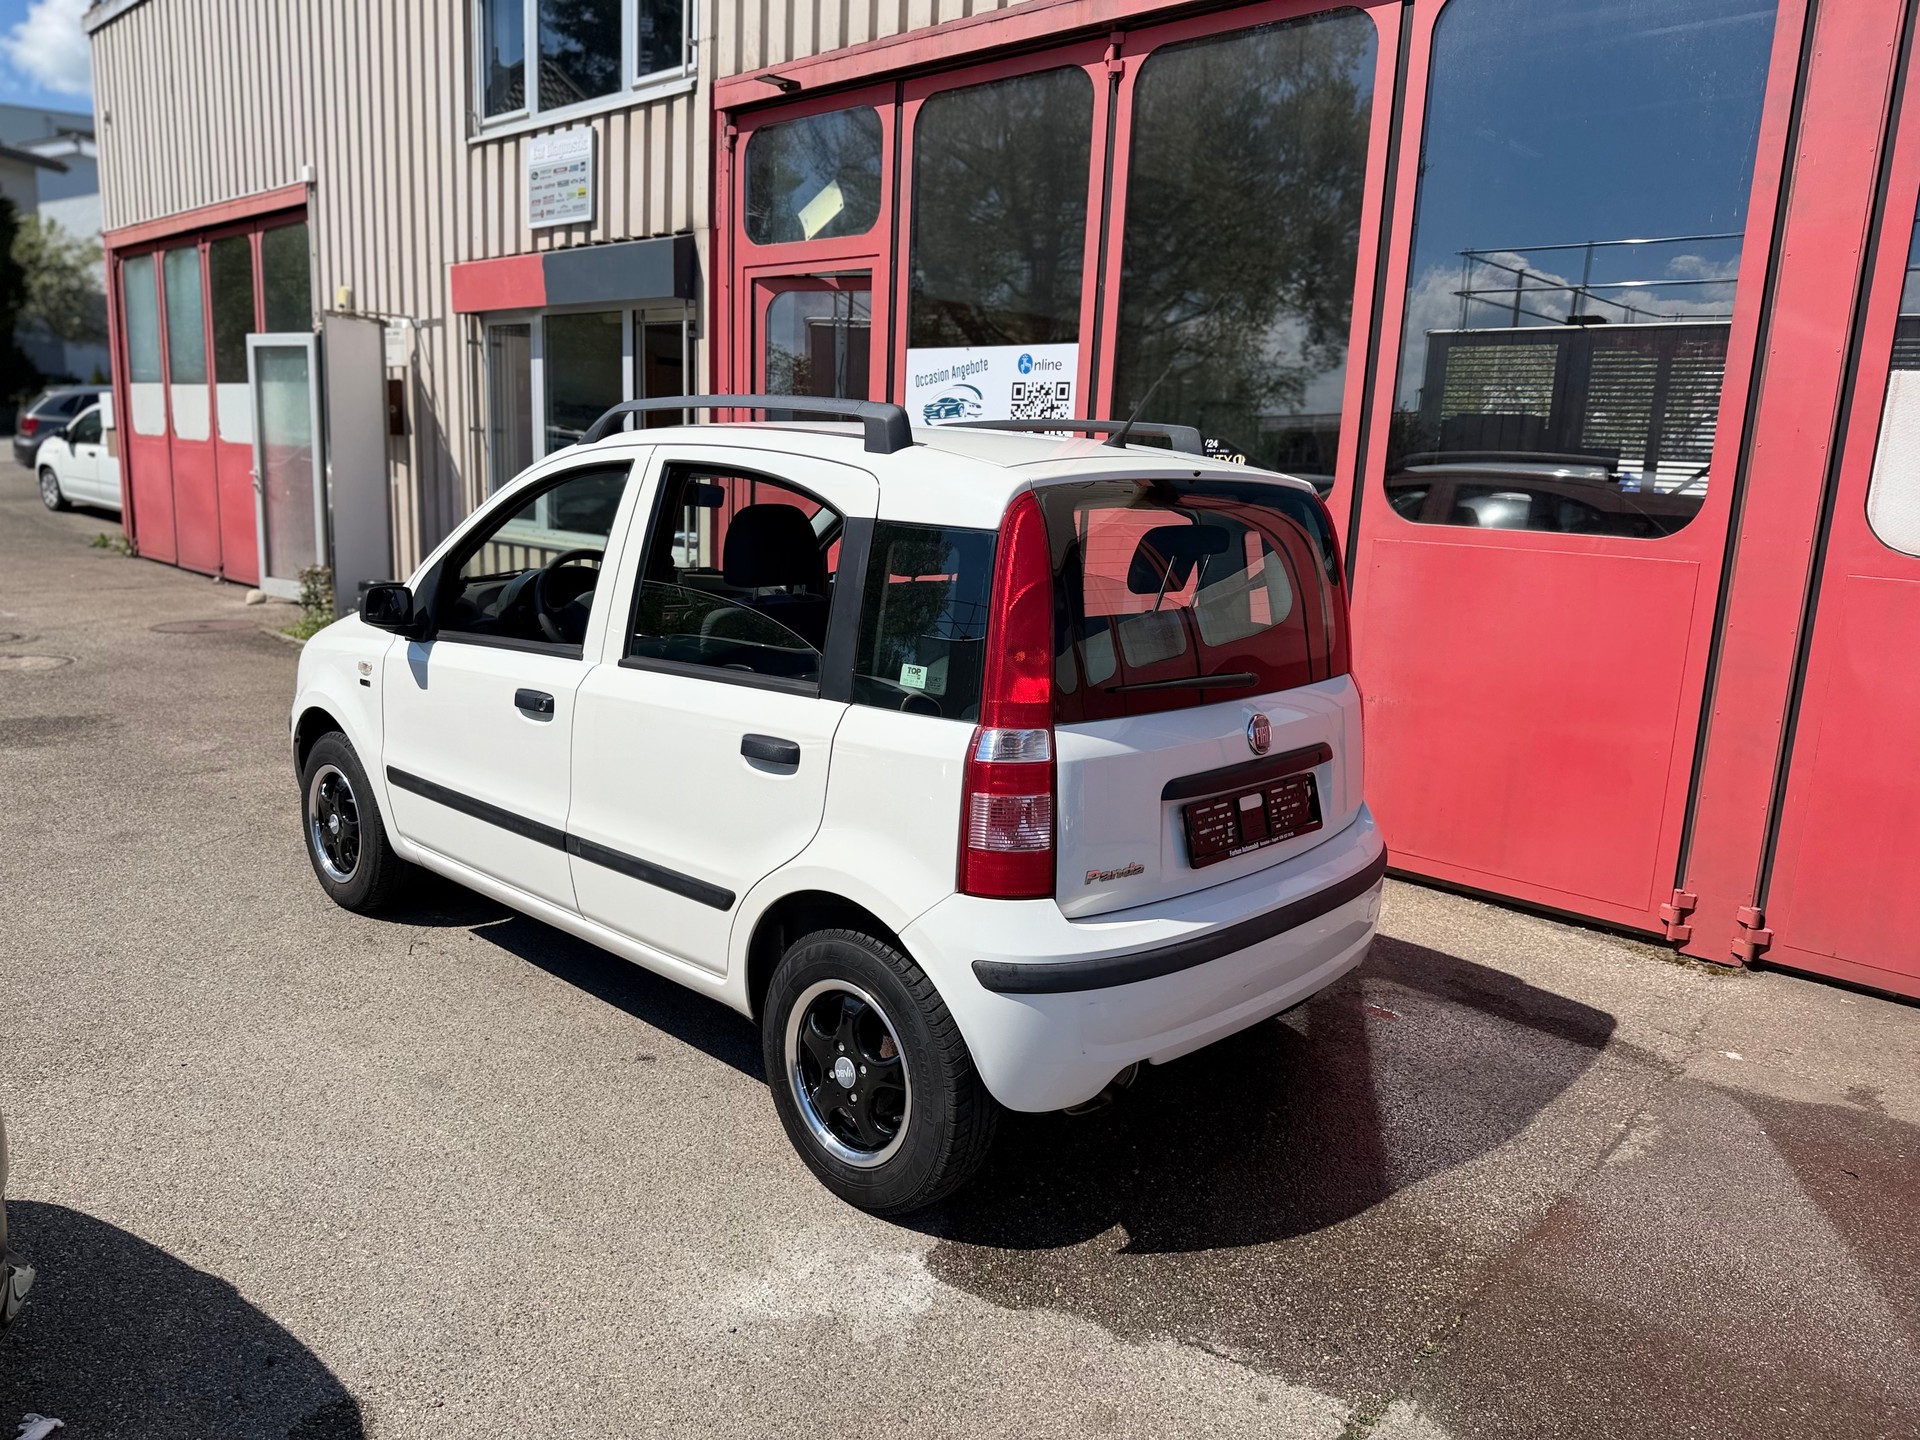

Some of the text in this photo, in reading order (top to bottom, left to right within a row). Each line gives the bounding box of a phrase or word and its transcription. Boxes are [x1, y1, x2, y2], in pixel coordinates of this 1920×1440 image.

[915, 358, 989, 388] Occasion Angebote
[908, 667, 921, 675] TOP
[1256, 726, 1268, 745] FIAT
[1084, 862, 1145, 885] Panda
